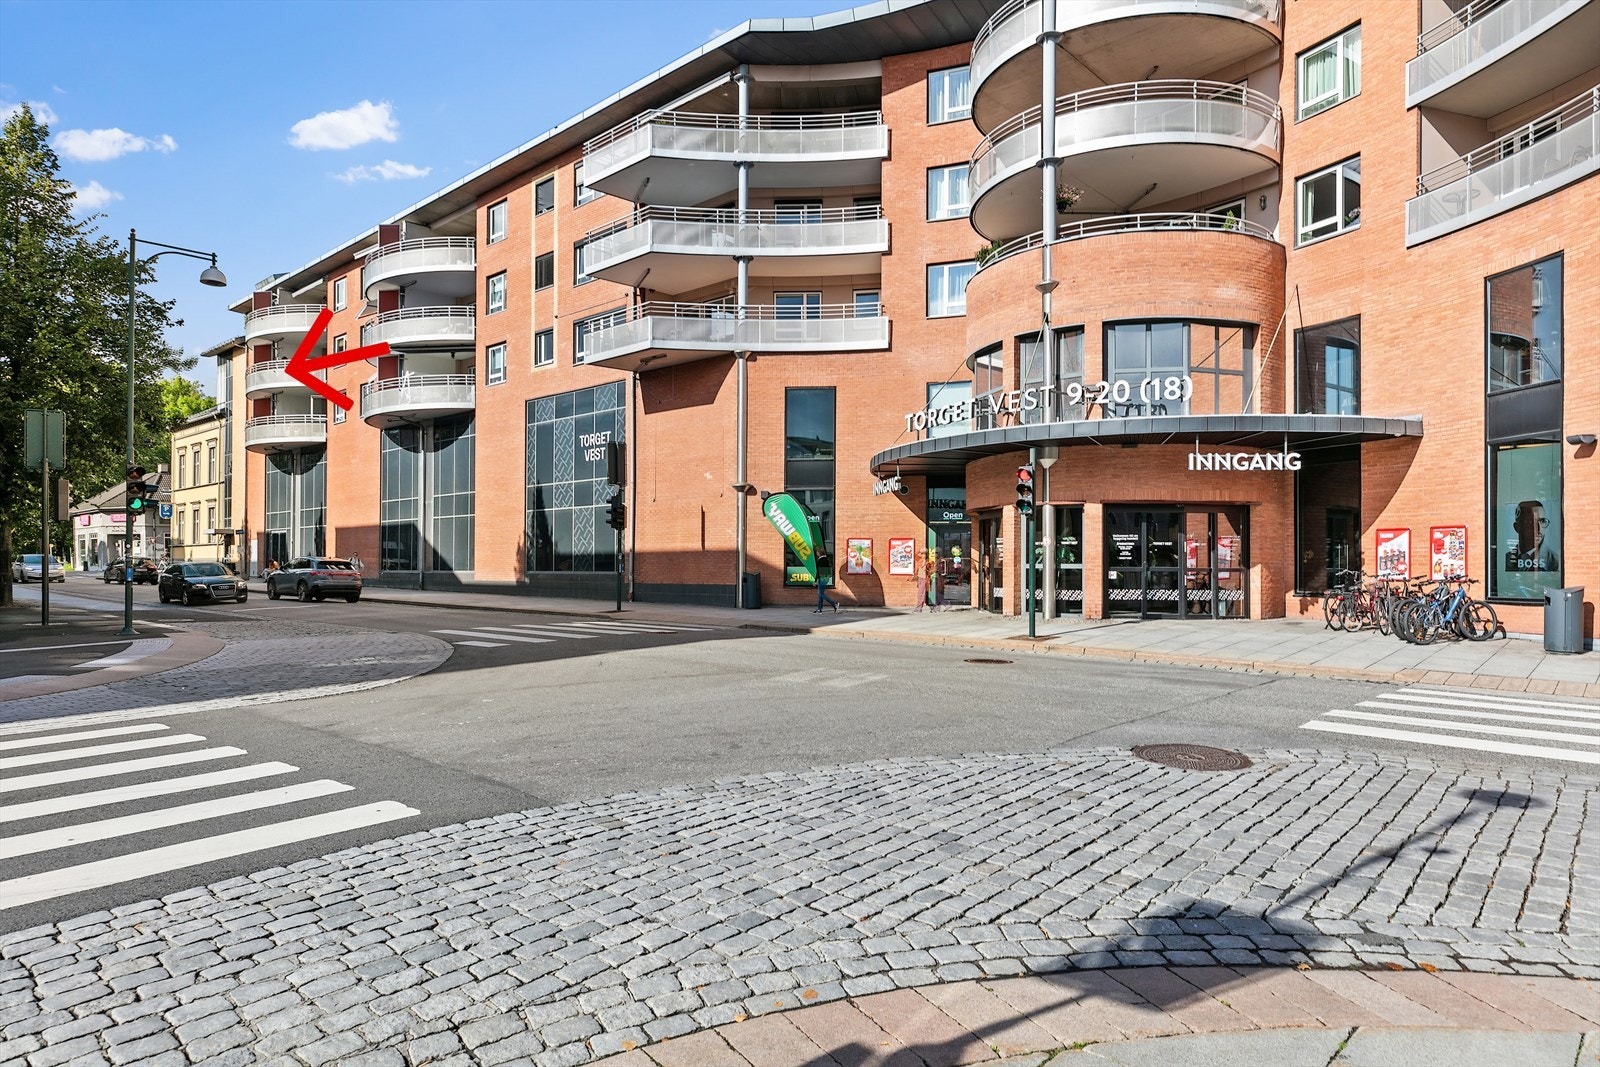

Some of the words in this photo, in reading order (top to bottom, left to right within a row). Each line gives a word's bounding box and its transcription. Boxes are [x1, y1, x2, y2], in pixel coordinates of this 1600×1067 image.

[904, 398, 977, 432] TORGET
[988, 385, 1055, 415] VEST
[1066, 379, 1131, 406] 9-20
[1139, 375, 1193, 403] (18)
[579, 430, 611, 448] TORGET
[584, 447, 606, 462] VEST
[1188, 452, 1302, 471] INNGANG
[873, 476, 902, 496] INNGANG
[942, 511, 963, 520] Open
[1517, 559, 1546, 568] BOSS
